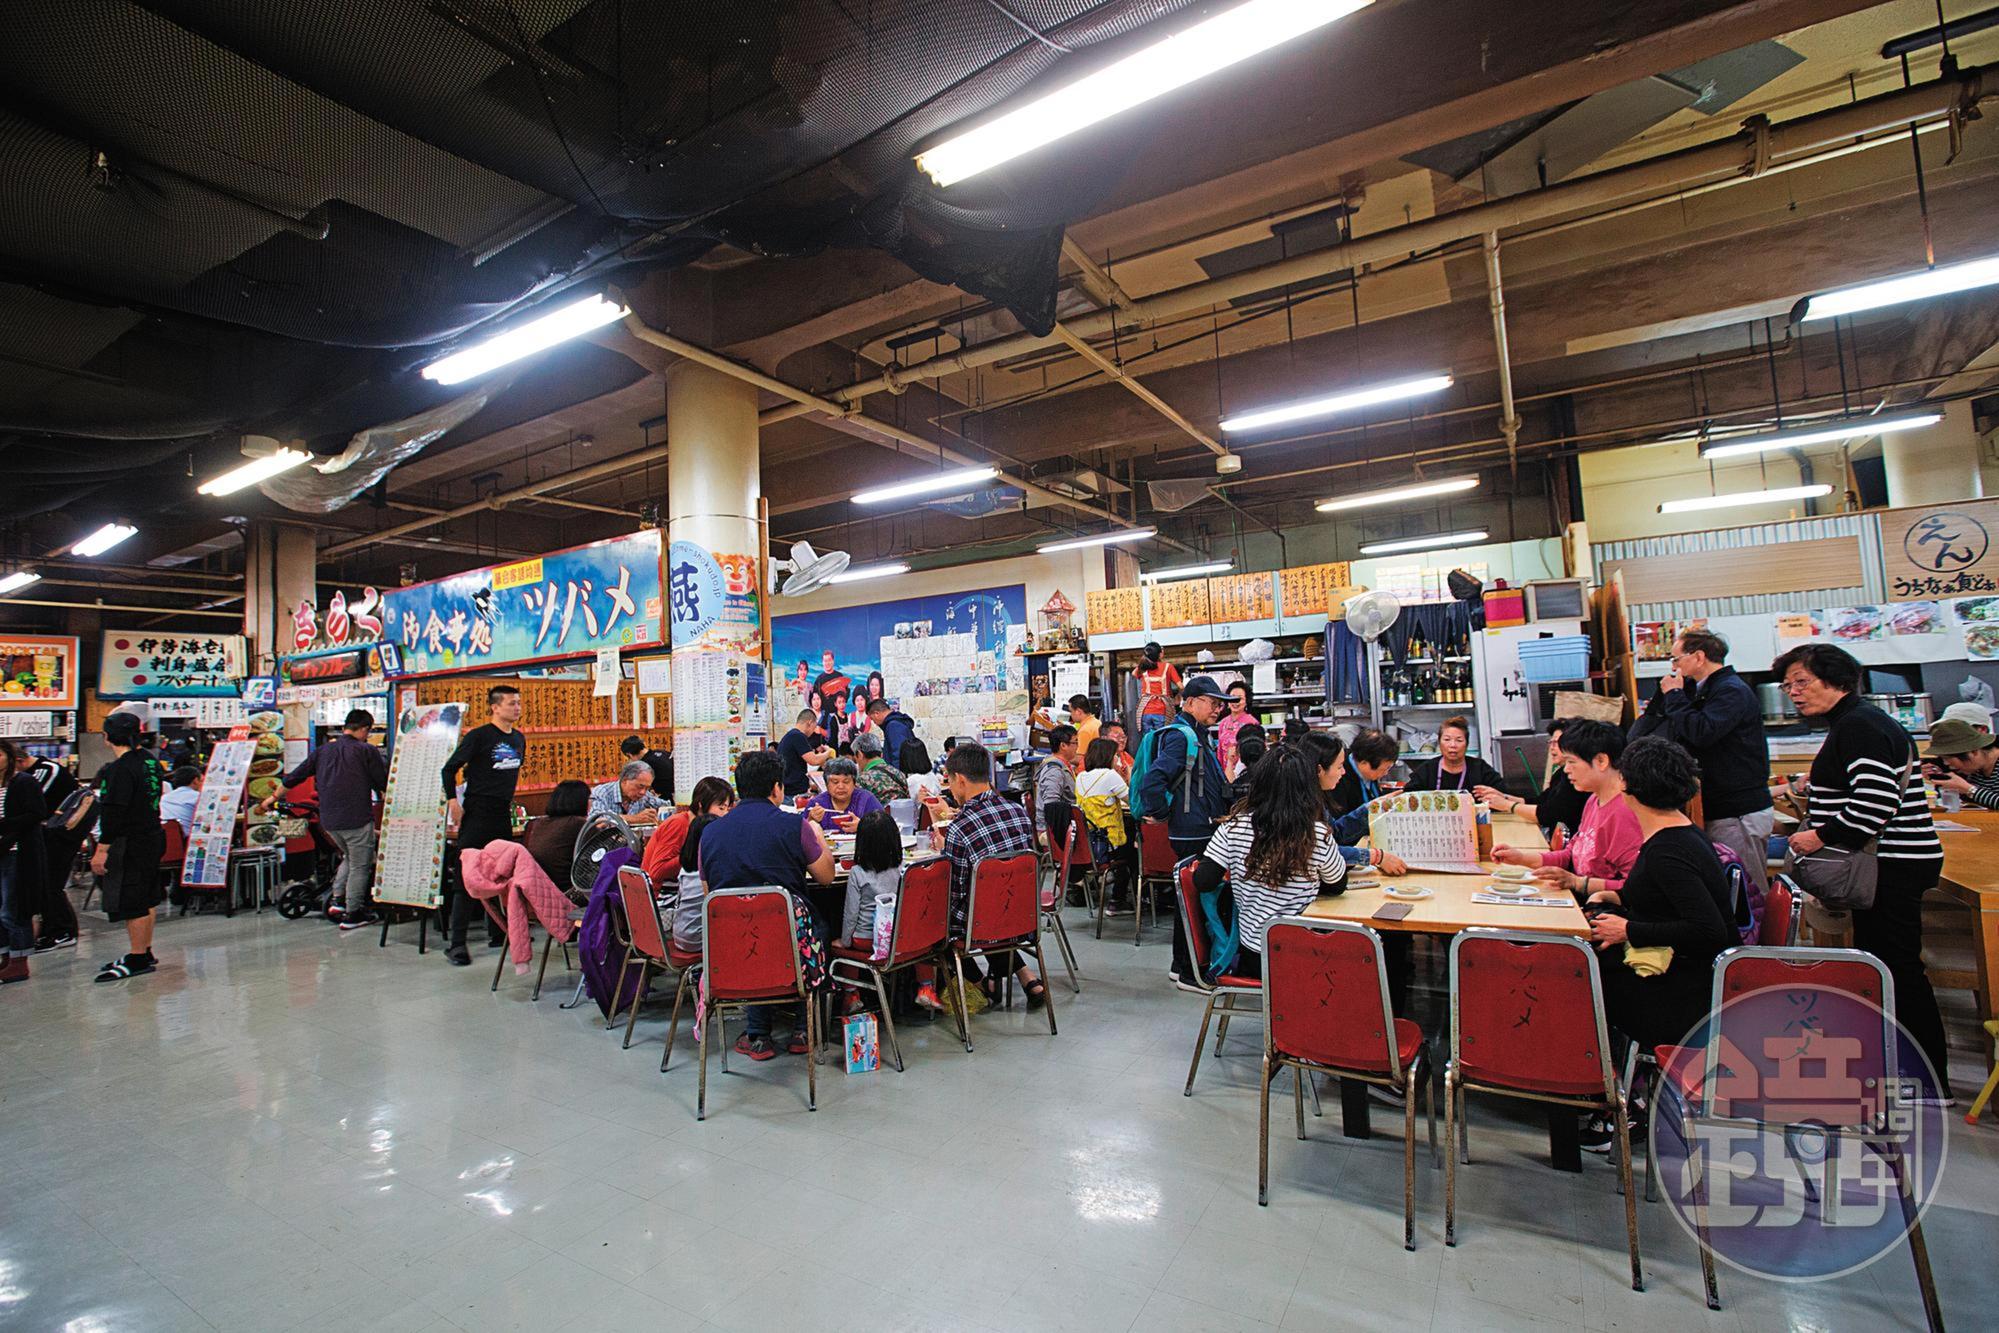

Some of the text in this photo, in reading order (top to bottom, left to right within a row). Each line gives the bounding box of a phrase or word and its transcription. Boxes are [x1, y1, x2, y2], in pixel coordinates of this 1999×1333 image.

[1917, 518, 1974, 569] えん
[522, 565, 636, 650] ツバメ
[690, 615, 715, 638] NAHA
[138, 639, 225, 654] 伊勢海老
[402, 608, 492, 655] 御食事処
